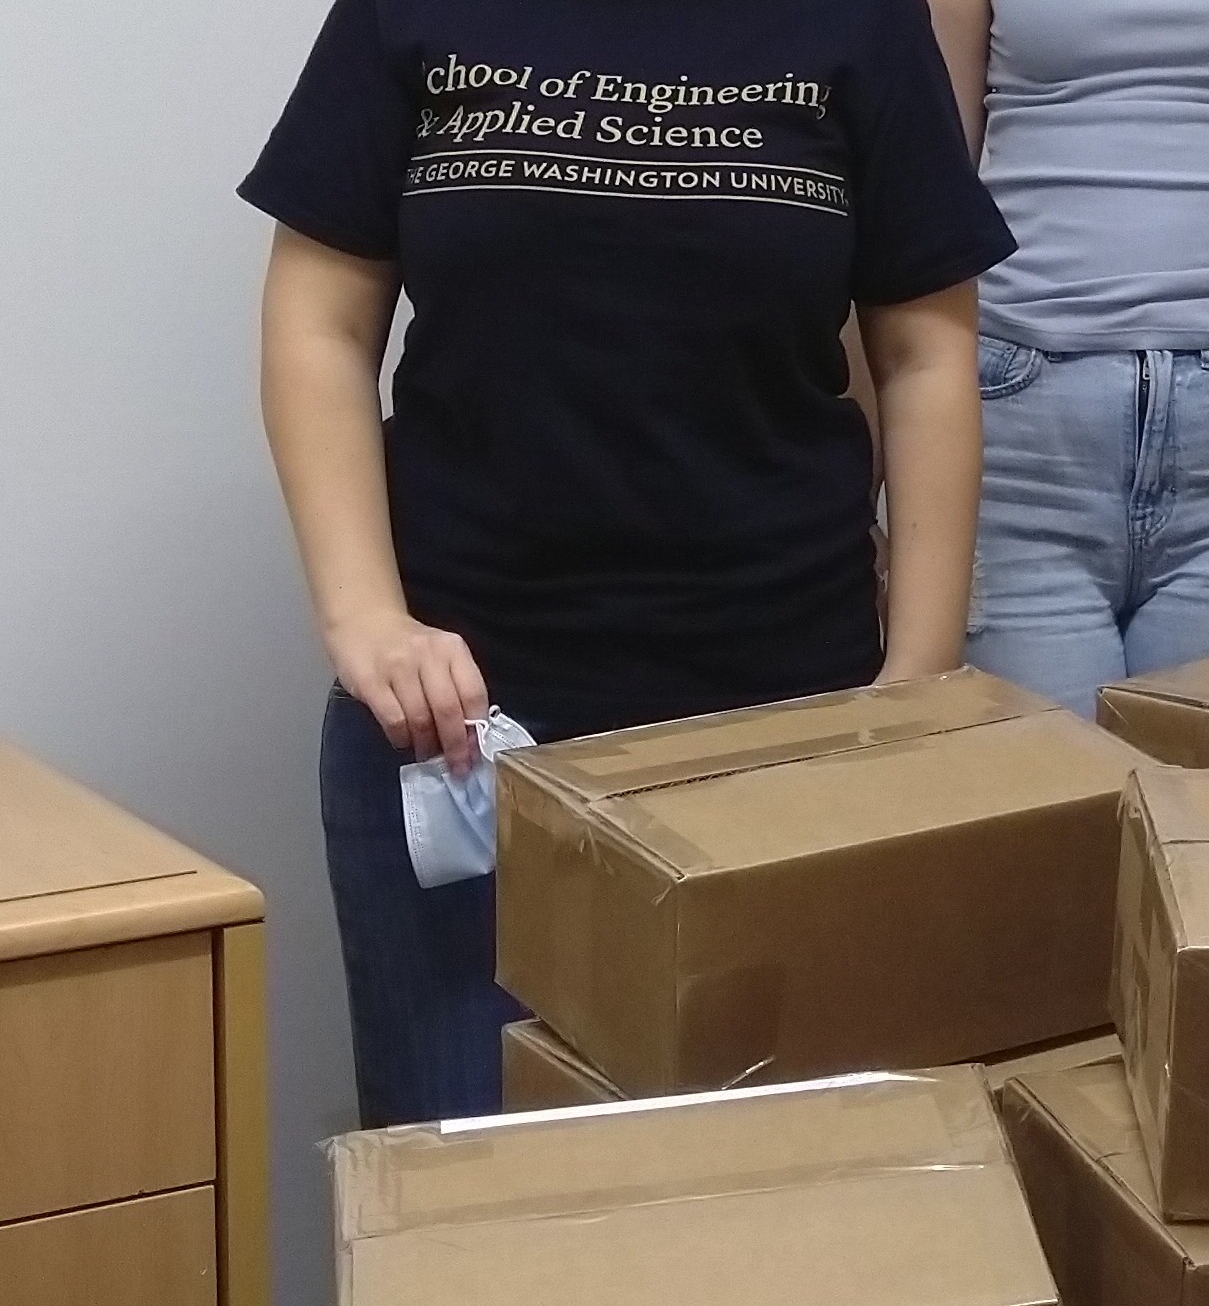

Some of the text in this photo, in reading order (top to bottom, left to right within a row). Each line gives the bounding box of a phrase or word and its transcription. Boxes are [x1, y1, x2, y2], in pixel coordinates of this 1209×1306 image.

[422, 54, 533, 95] chool
[540, 70, 591, 99] of
[416, 101, 764, 149] & Applied Science
[425, 160, 516, 182] GEORGE
[523, 161, 720, 189] WASHINGTON
